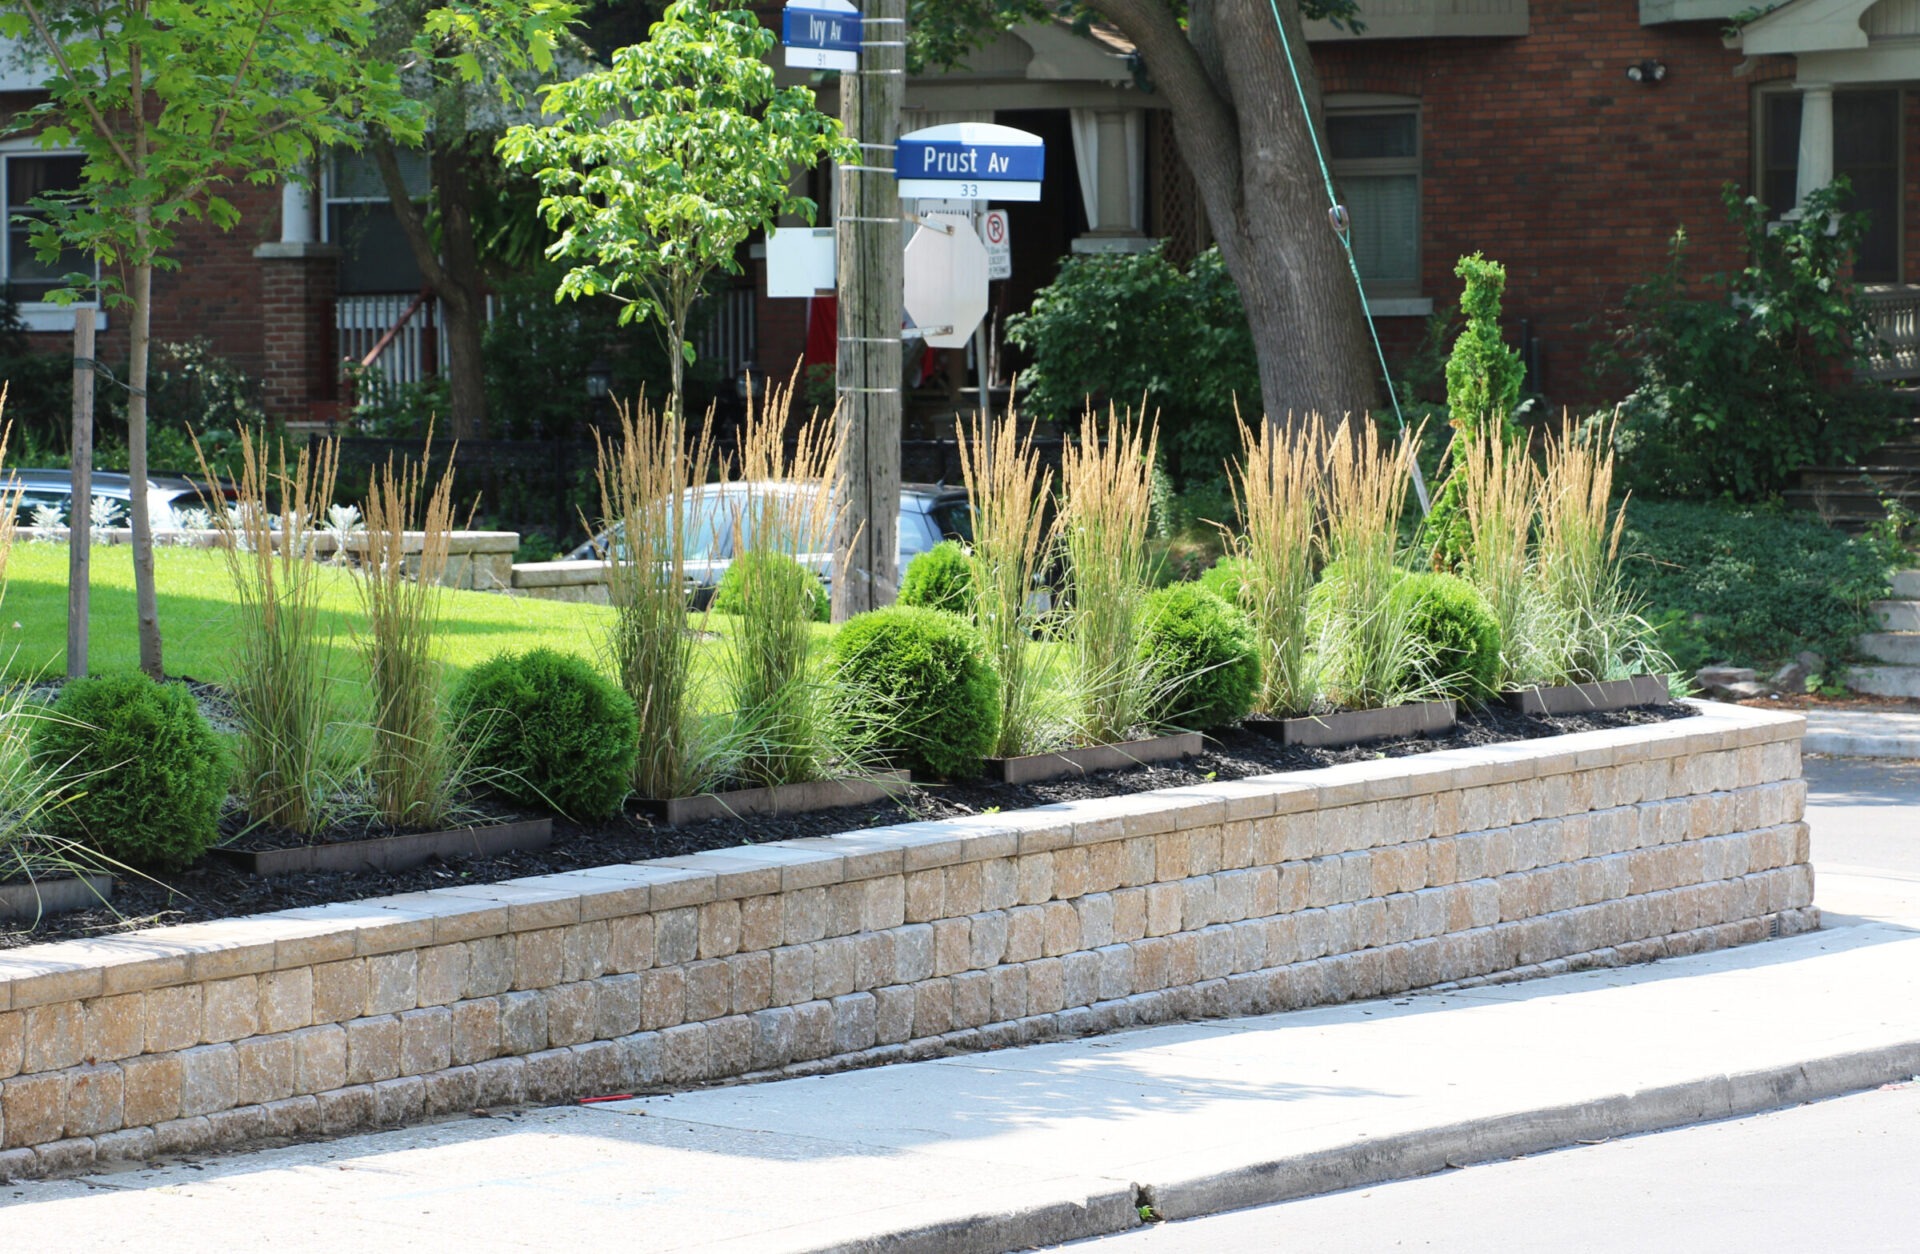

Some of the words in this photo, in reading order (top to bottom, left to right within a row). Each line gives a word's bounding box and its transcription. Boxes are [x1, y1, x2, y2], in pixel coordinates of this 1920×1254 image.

[810, 14, 826, 47] Ivy
[830, 20, 842, 40] Av
[817, 52, 826, 66] 91
[923, 146, 978, 173] Prust
[988, 152, 1009, 173] Av
[961, 184, 978, 197] 33
